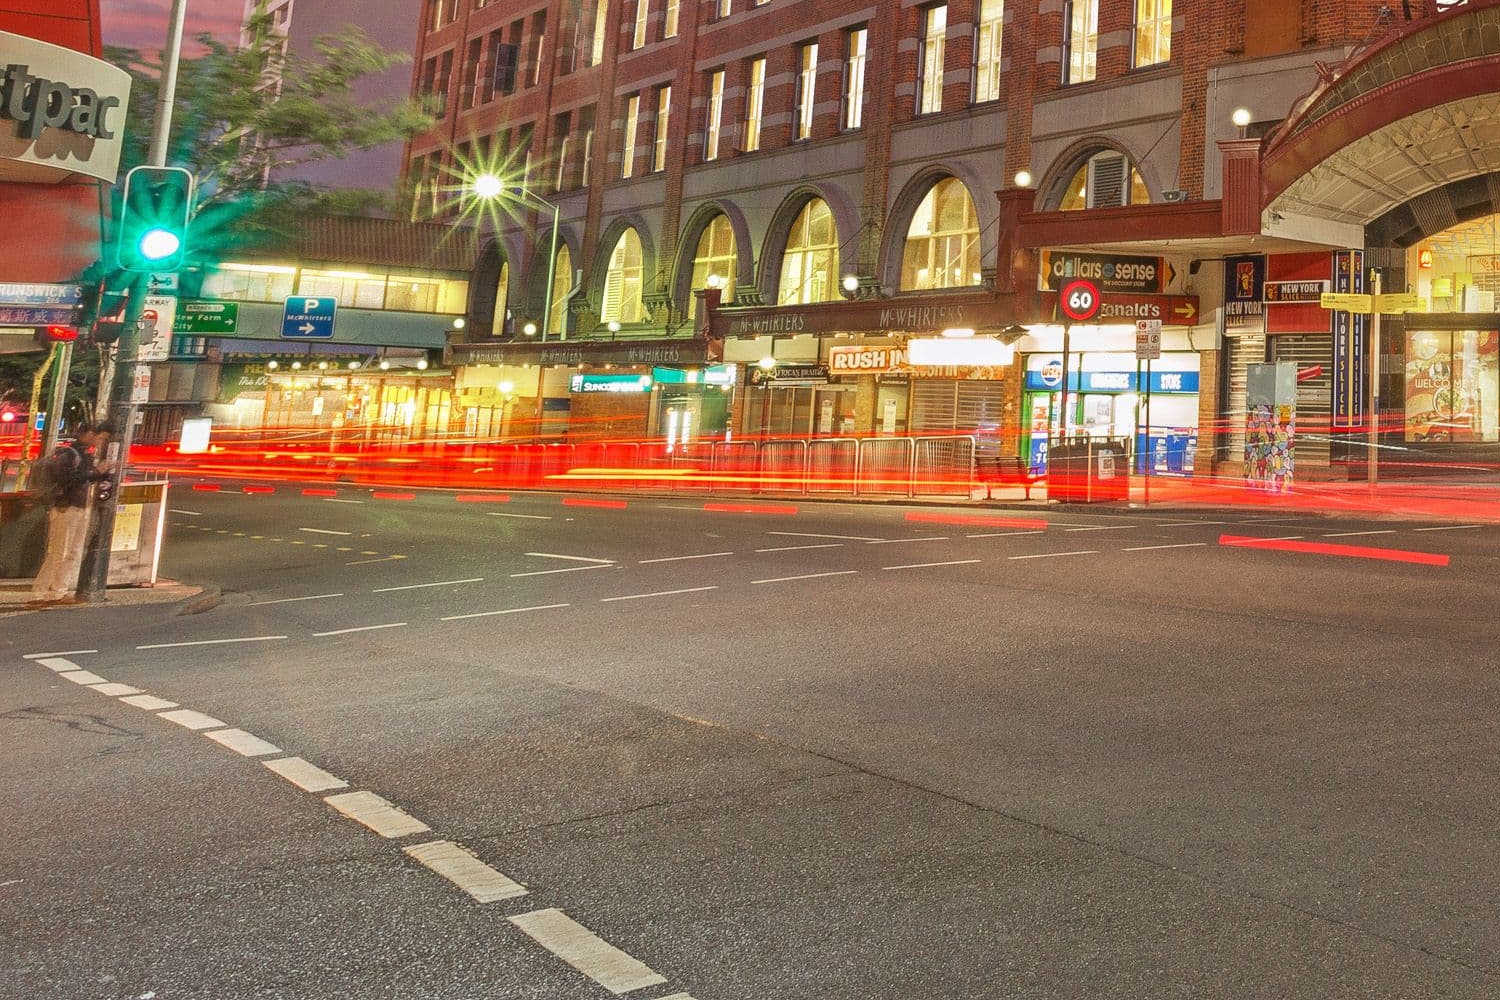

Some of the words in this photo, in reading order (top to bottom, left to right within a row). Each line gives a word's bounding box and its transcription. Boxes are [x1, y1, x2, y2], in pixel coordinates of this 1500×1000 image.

[1115, 263, 1155, 280] sense
[1281, 284, 1299, 293] NEW
[1300, 283, 1320, 293] YORK
[304, 299, 319, 313] P
[1069, 292, 1093, 309] 60
[1226, 302, 1243, 315] NEW
[1243, 301, 1262, 315] YORK
[1100, 302, 1160, 317] onald's
[834, 350, 885, 370] RUSH
[890, 348, 910, 367] IN
